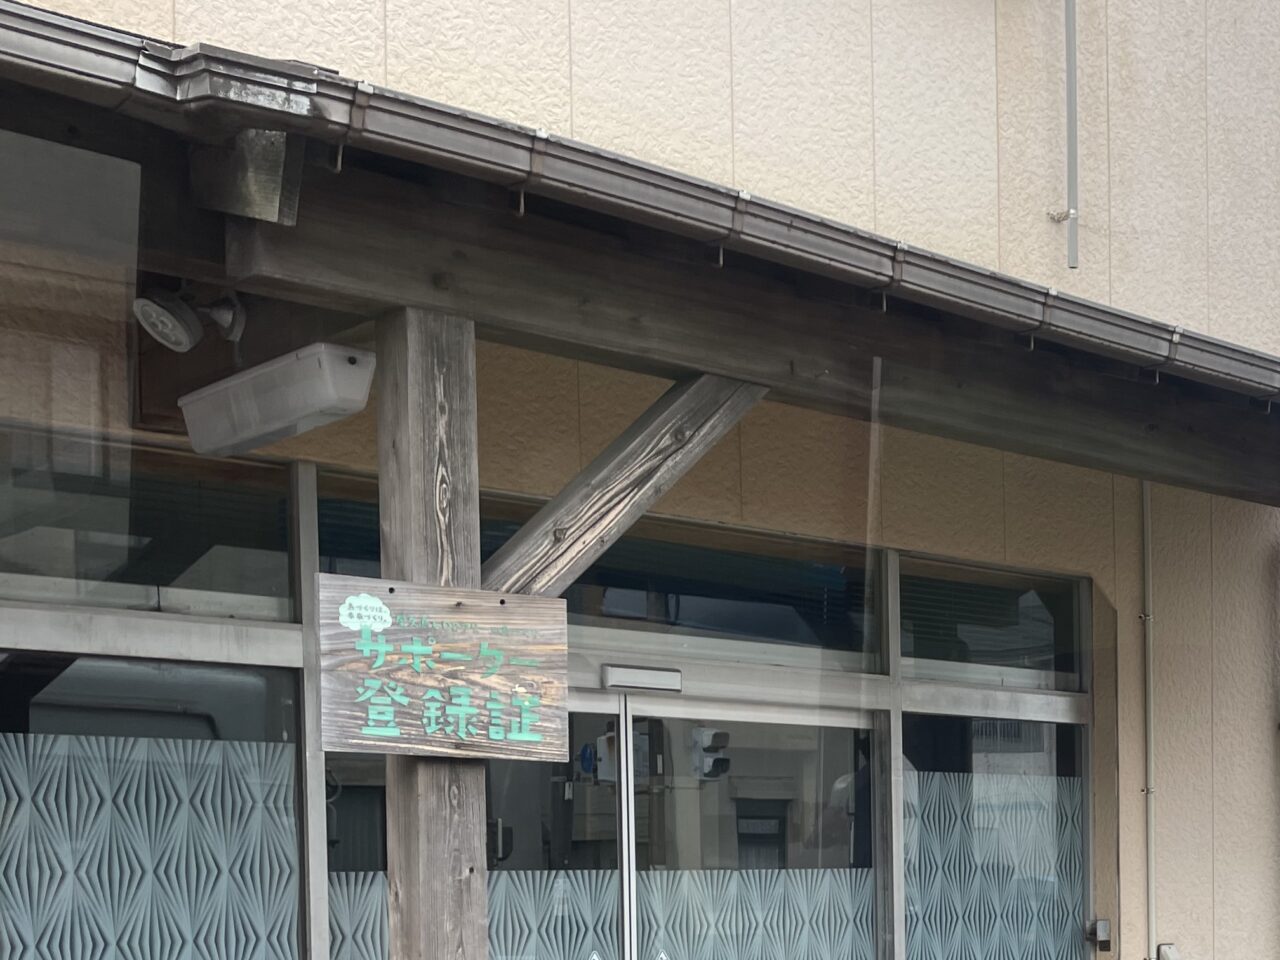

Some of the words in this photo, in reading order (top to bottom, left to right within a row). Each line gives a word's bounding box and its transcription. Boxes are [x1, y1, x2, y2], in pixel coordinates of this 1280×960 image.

[355, 628, 540, 679] サポーター
[355, 678, 545, 742] 登録証
